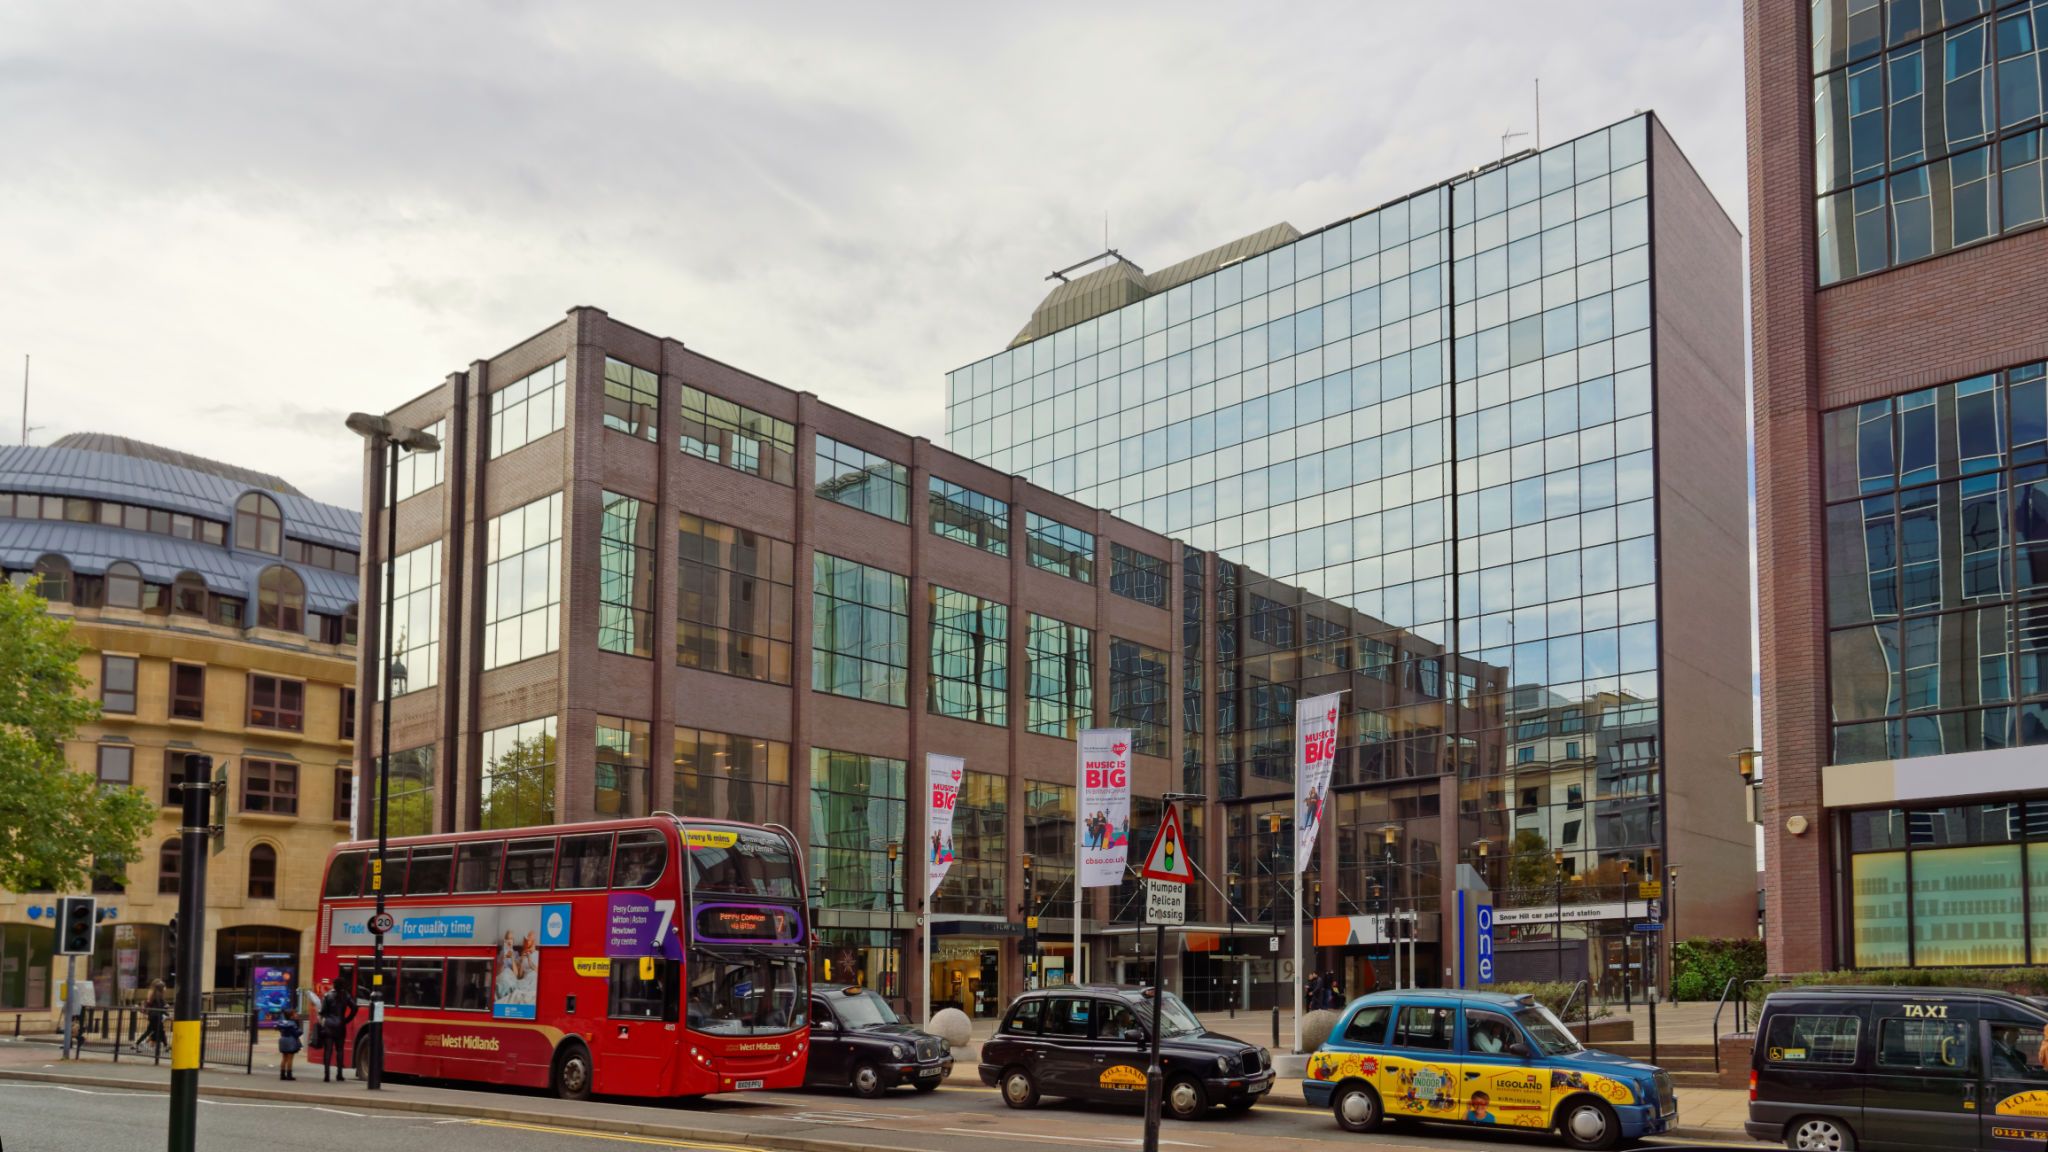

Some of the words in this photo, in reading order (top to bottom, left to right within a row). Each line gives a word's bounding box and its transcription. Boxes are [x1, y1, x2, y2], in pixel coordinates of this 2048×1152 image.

[1305, 730, 1329, 743] MUSIC
[1305, 738, 1335, 764] BIG
[1086, 761, 1115, 769] MUSIC
[1086, 769, 1126, 789] BIG
[933, 783, 954, 793] MUSIC
[932, 790, 957, 810] BIG
[1085, 856, 1125, 865] cbso.co.uk
[1150, 881, 1183, 893] Humped
[1152, 894, 1181, 907] Pelican
[613, 904, 626, 914] Perry
[632, 916, 647, 924] Aston
[720, 913, 740, 922] Perry
[741, 913, 766, 922] Common
[1544, 912, 1560, 921] park
[1577, 909, 1601, 917] station
[343, 922, 365, 934] Trade
[377, 918, 391, 928] 20
[403, 921, 416, 934] for
[418, 922, 449, 937] quality
[450, 919, 473, 934] time.
[654, 899, 676, 947] 7
[776, 915, 785, 934] 7
[611, 927, 636, 935] Newtown
[611, 937, 620, 946] city
[1478, 908, 1493, 979] one
[577, 962, 592, 972] every
[597, 962, 610, 970] mins
[1903, 1004, 1947, 1018] TAXI
[441, 1034, 461, 1048] West
[462, 1035, 499, 1051] Midlands
[740, 1043, 755, 1051] West
[756, 1042, 781, 1051] Midlands
[1413, 1078, 1440, 1088] INDOOR
[1496, 1079, 1543, 1090] LEGOLAND
[1498, 1096, 1541, 1104] BIRMINGHAM
[2004, 1093, 2042, 1110] T.O.A.
[1994, 1128, 2025, 1137] 0121
